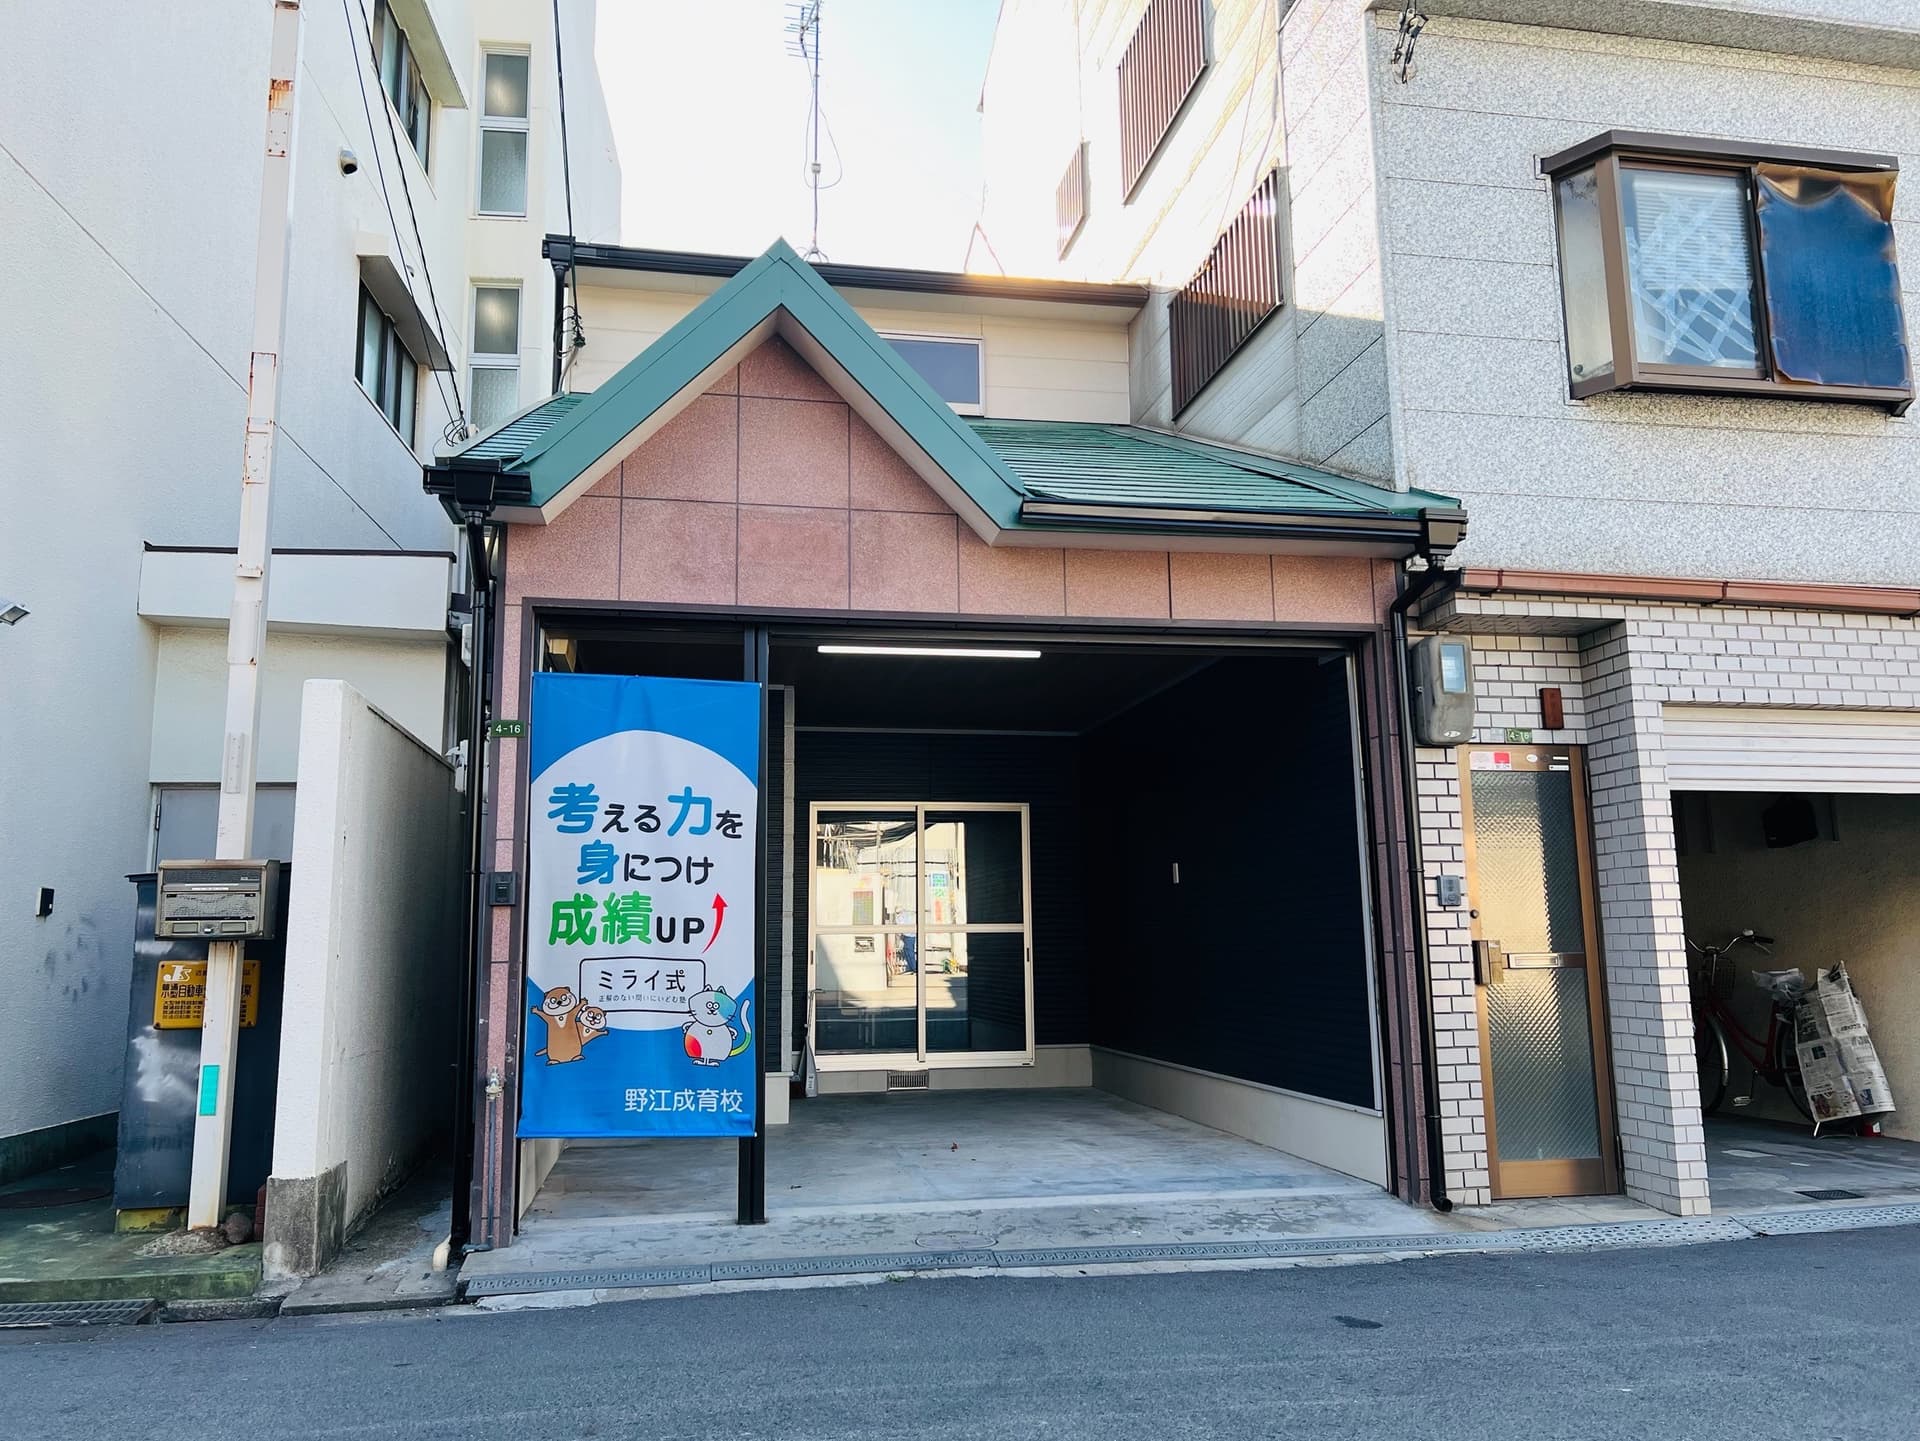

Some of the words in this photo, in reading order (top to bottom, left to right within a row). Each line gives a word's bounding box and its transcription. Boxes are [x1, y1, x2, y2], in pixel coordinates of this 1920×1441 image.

[495, 724, 521, 734] 4-16
[547, 782, 744, 840] 考える力を
[576, 838, 714, 886] 身につけ
[548, 890, 706, 947] 成績UP
[598, 969, 687, 993] ミライ式
[624, 1088, 742, 1113] 野江成育校
